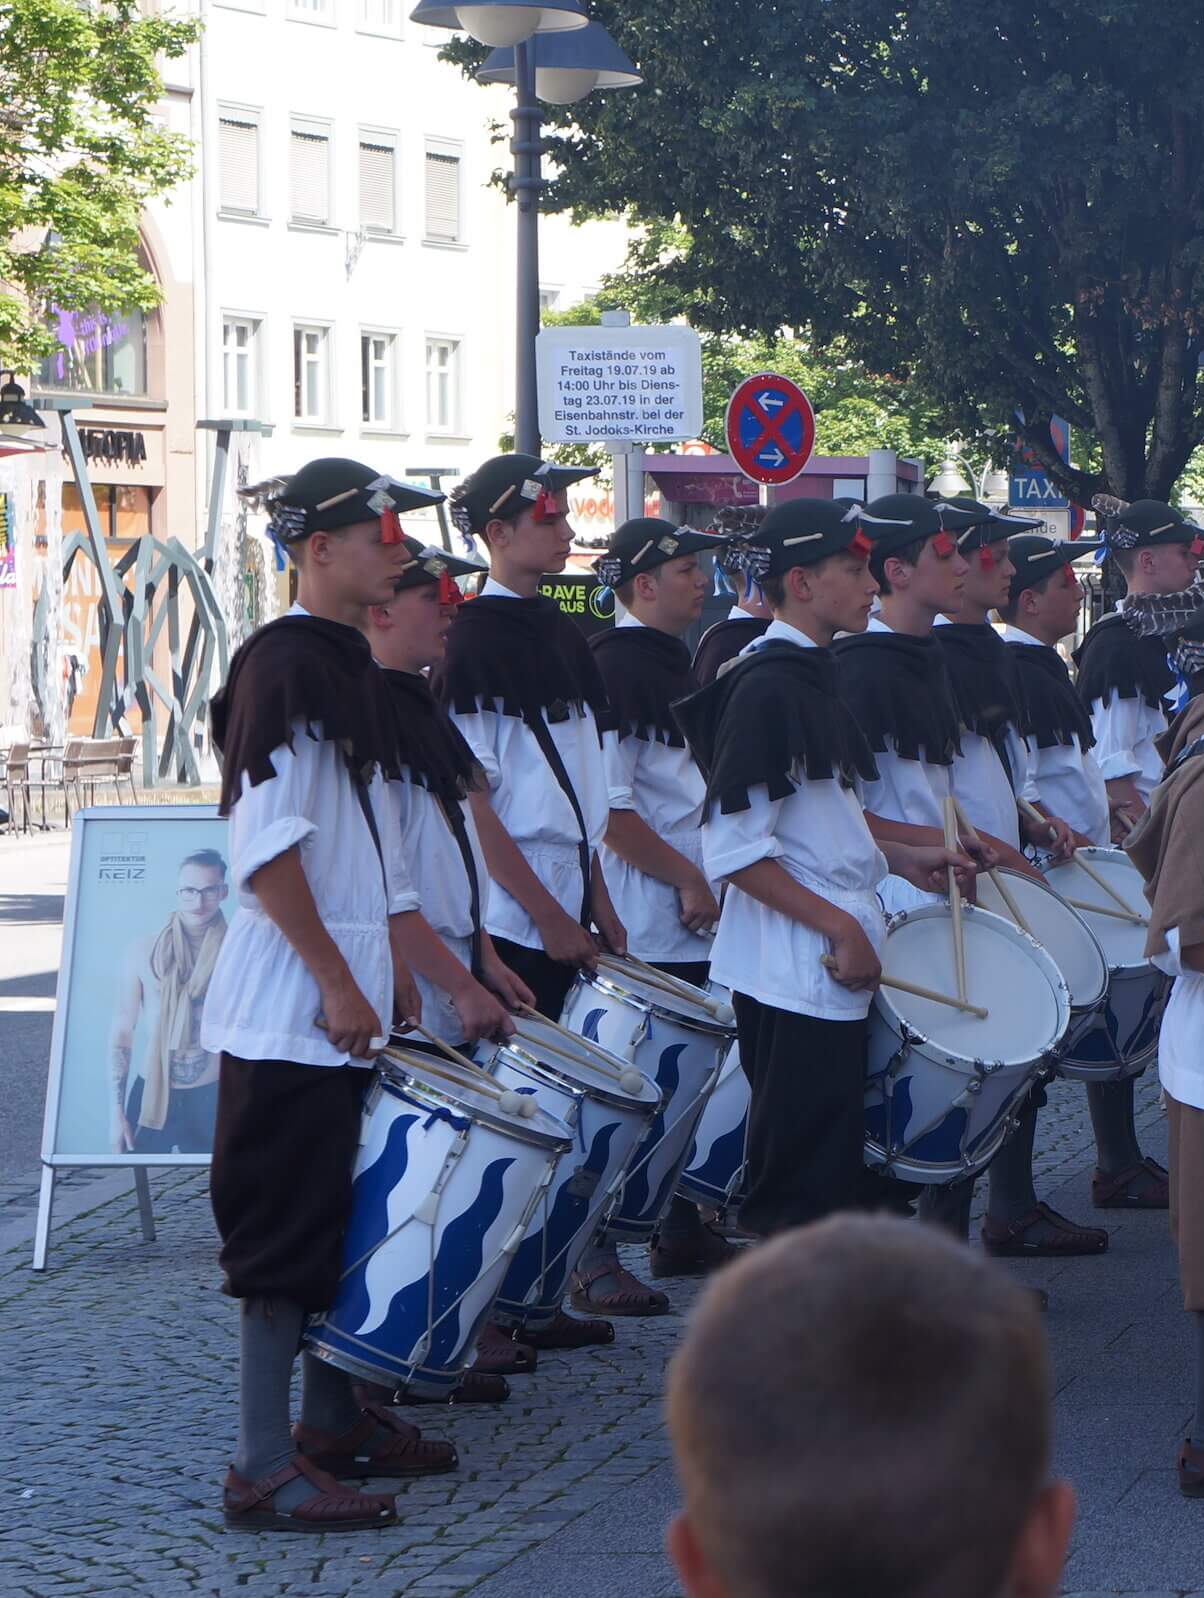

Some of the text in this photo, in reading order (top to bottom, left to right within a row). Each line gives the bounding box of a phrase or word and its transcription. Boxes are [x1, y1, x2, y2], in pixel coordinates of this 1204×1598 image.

[569, 350, 666, 361] Taxistände vom
[560, 365, 676, 378] Freitag 19.07.19 ab
[558, 379, 680, 391] 14:00 Uhr bis Diens-
[563, 394, 675, 408] tag 23.07.19 in der
[555, 409, 685, 421] Eisenbahnstr. bei der
[565, 424, 675, 436] St. Jodoks-Kirche
[559, 601, 586, 614] AUS
